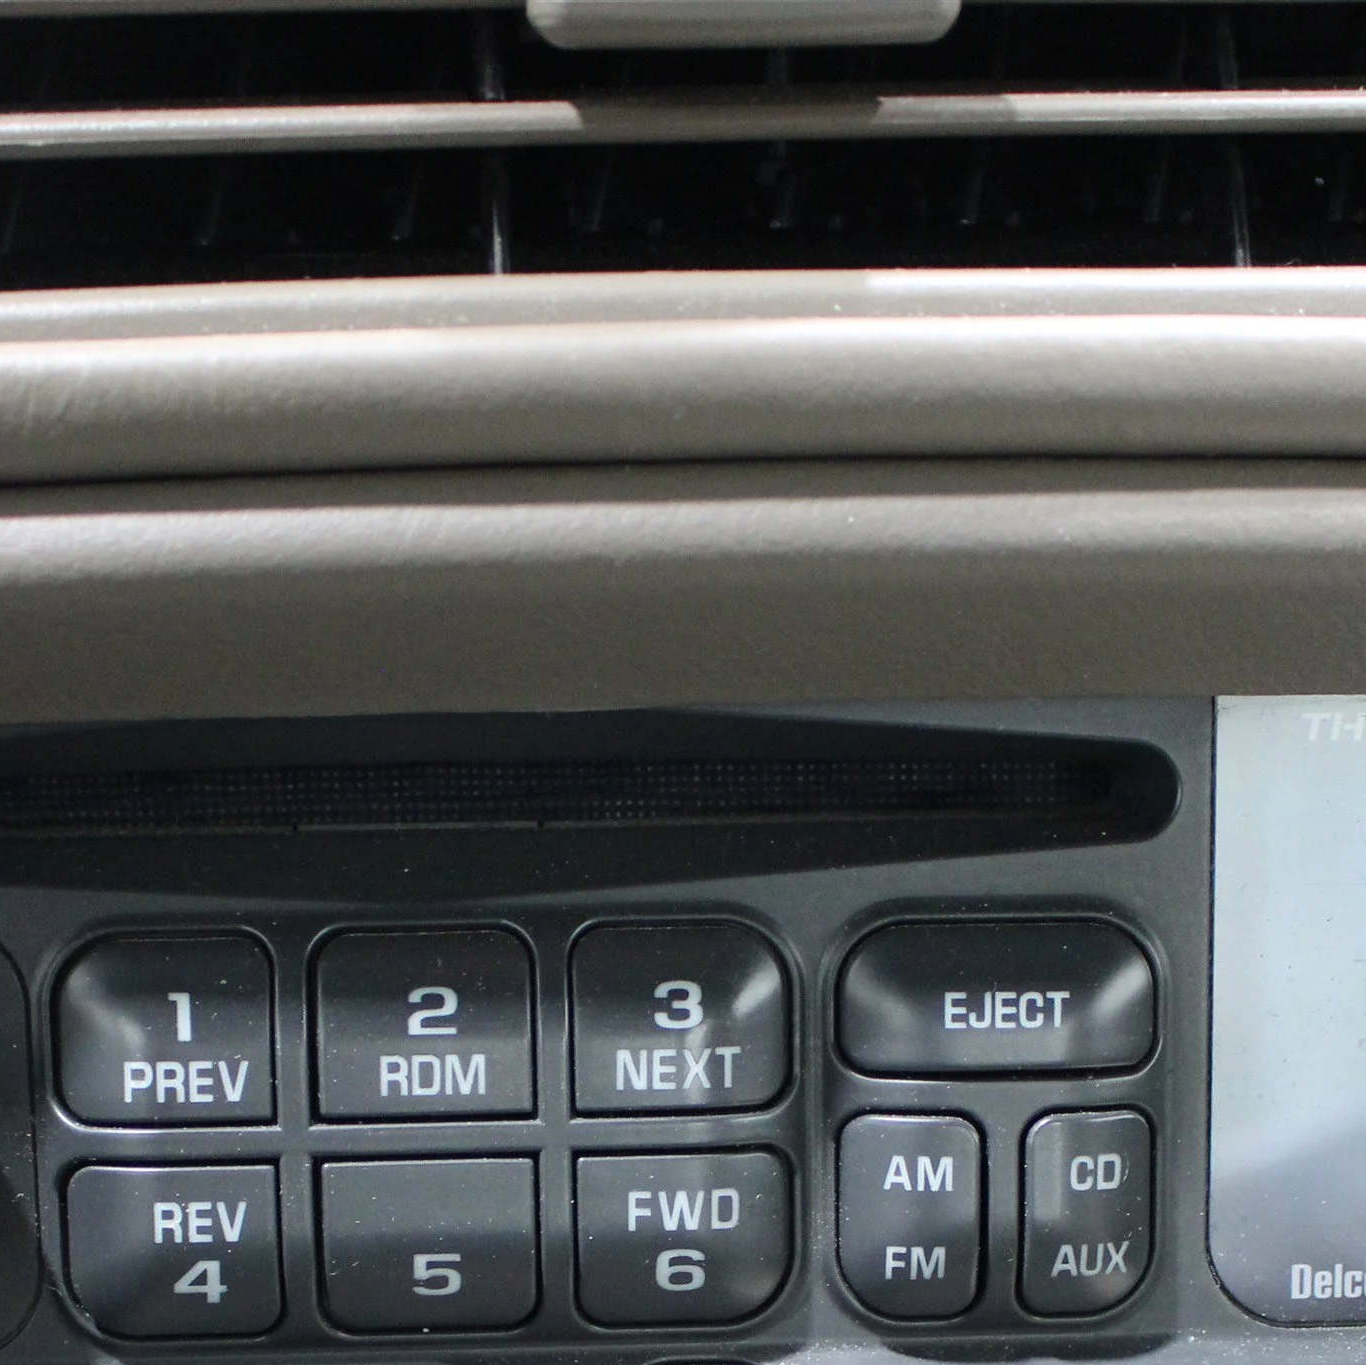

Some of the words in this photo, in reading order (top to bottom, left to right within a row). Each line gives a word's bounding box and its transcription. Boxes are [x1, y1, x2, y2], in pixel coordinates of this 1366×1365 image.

[169, 993, 193, 1043] 1
[406, 987, 458, 1038] 2
[653, 980, 705, 1031] 3
[943, 991, 1071, 1030] EJECT
[123, 1060, 249, 1104] PREV
[379, 1053, 486, 1097] RDM
[615, 1046, 741, 1092] NEXT
[883, 1154, 954, 1192] AM
[1069, 1153, 1125, 1192] CD
[153, 1201, 247, 1244] REV
[627, 1188, 740, 1232] FWD
[413, 1253, 462, 1296] 5
[655, 1248, 706, 1291] 6
[884, 1245, 946, 1280] FM
[1051, 1240, 1130, 1277] AUX
[174, 1259, 228, 1303] 4
